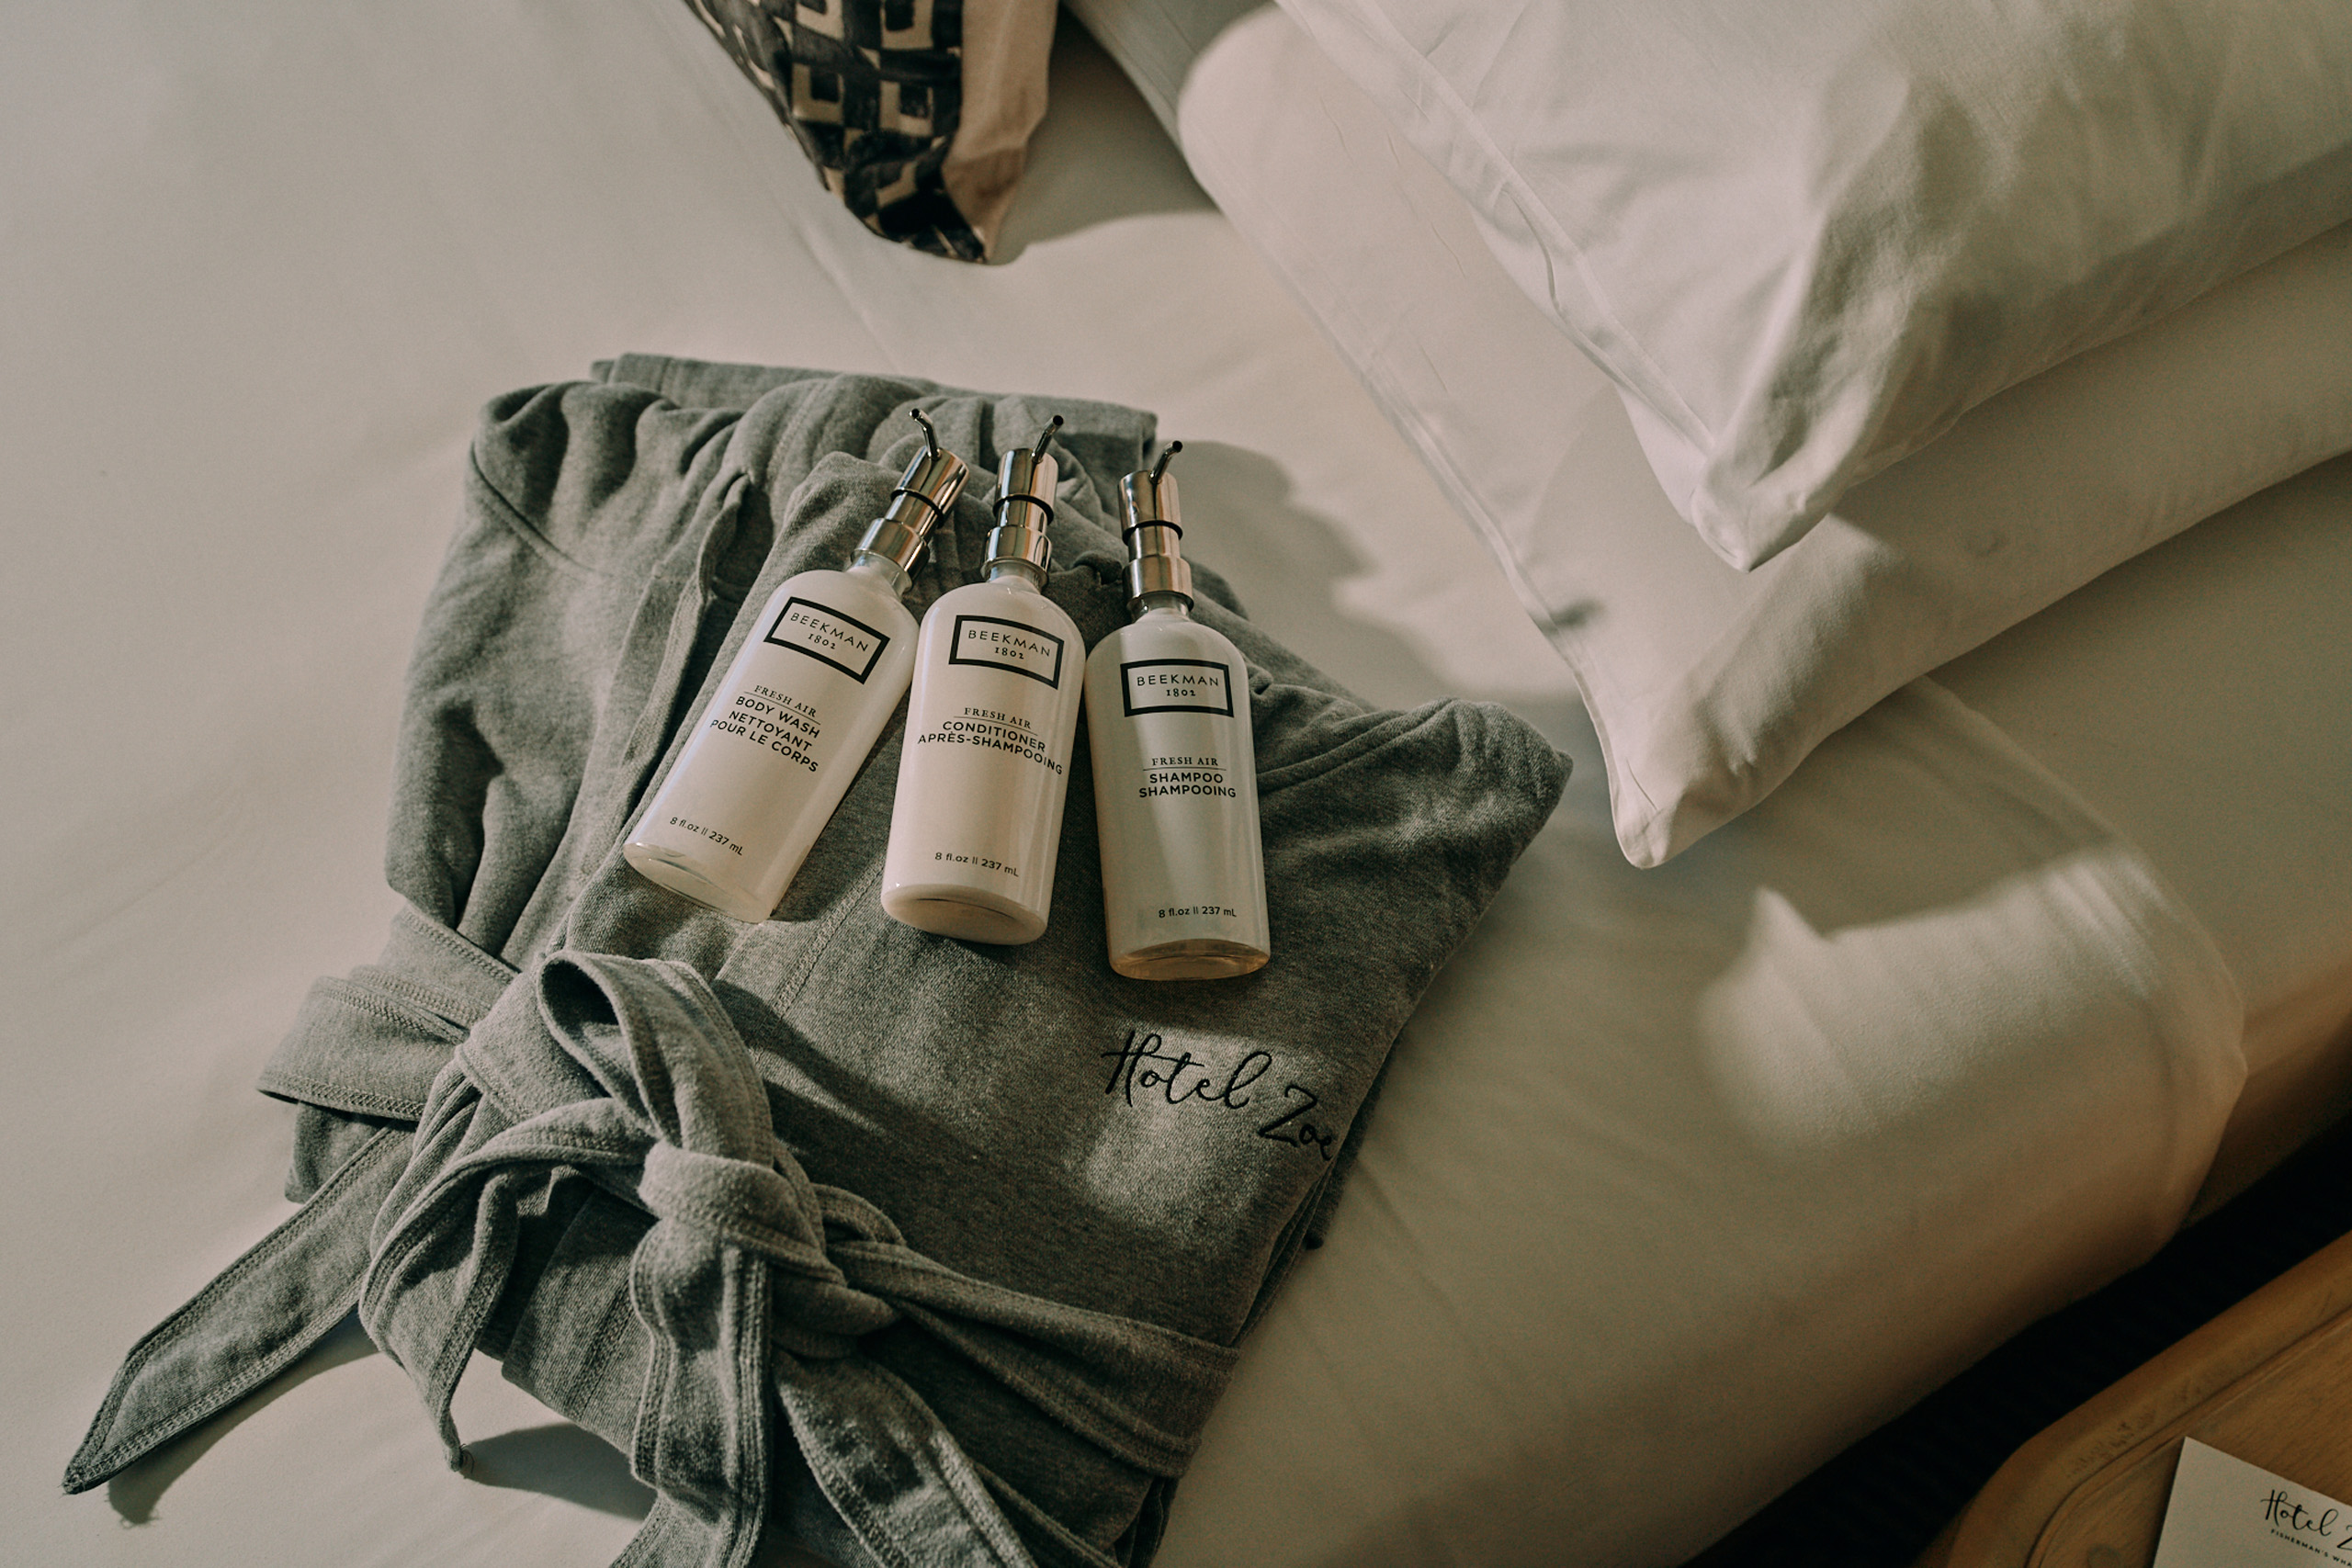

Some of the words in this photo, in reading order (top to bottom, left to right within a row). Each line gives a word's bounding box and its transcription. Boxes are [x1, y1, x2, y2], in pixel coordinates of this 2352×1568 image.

[790, 612, 869, 652] BEEKMAN
[808, 633, 836, 649] 1802
[968, 629, 1051, 657] BEEKMAN
[995, 647, 1025, 660] 1802
[1136, 673, 1219, 687] BEEKMAN
[1166, 688, 1196, 697] 1802
[754, 685, 792, 706] FRESH
[795, 702, 817, 717] AIR
[729, 710, 812, 751] NETTOYANT
[736, 696, 775, 716] BODY
[778, 711, 820, 739] WASH
[964, 707, 1007, 722] FRESH
[1010, 717, 1032, 729] AIR
[710, 719, 746, 737] POUR
[750, 731, 766, 746] LE
[771, 740, 819, 773] CORPS
[943, 721, 1046, 752] CONDITIONER
[918, 730, 1063, 774] APRÈS-SHAMPOOING
[1151, 757, 1193, 766] FRESH
[1197, 757, 1218, 766] AIR
[1138, 784, 1237, 798] SHAMPOOING
[1149, 773, 1224, 784] SHAMPOO
[670, 817, 677, 826] 8
[679, 818, 699, 834] fl.oz
[708, 830, 729, 846] 237
[729, 842, 743, 855] mL
[934, 852, 943, 861] 8
[945, 852, 969, 863] fl.oz
[981, 859, 1001, 870] 237
[1004, 866, 1019, 877] mL
[1159, 909, 1166, 919] 8
[1169, 907, 1191, 917] fl.oz
[1202, 906, 1221, 915] 237
[1224, 908, 1237, 917] mL
[1102, 1030, 1272, 1110] Hotel
[2260, 1489, 2339, 1537] Hotel
[2271, 1529, 2329, 1558] FISHERMAN'S
